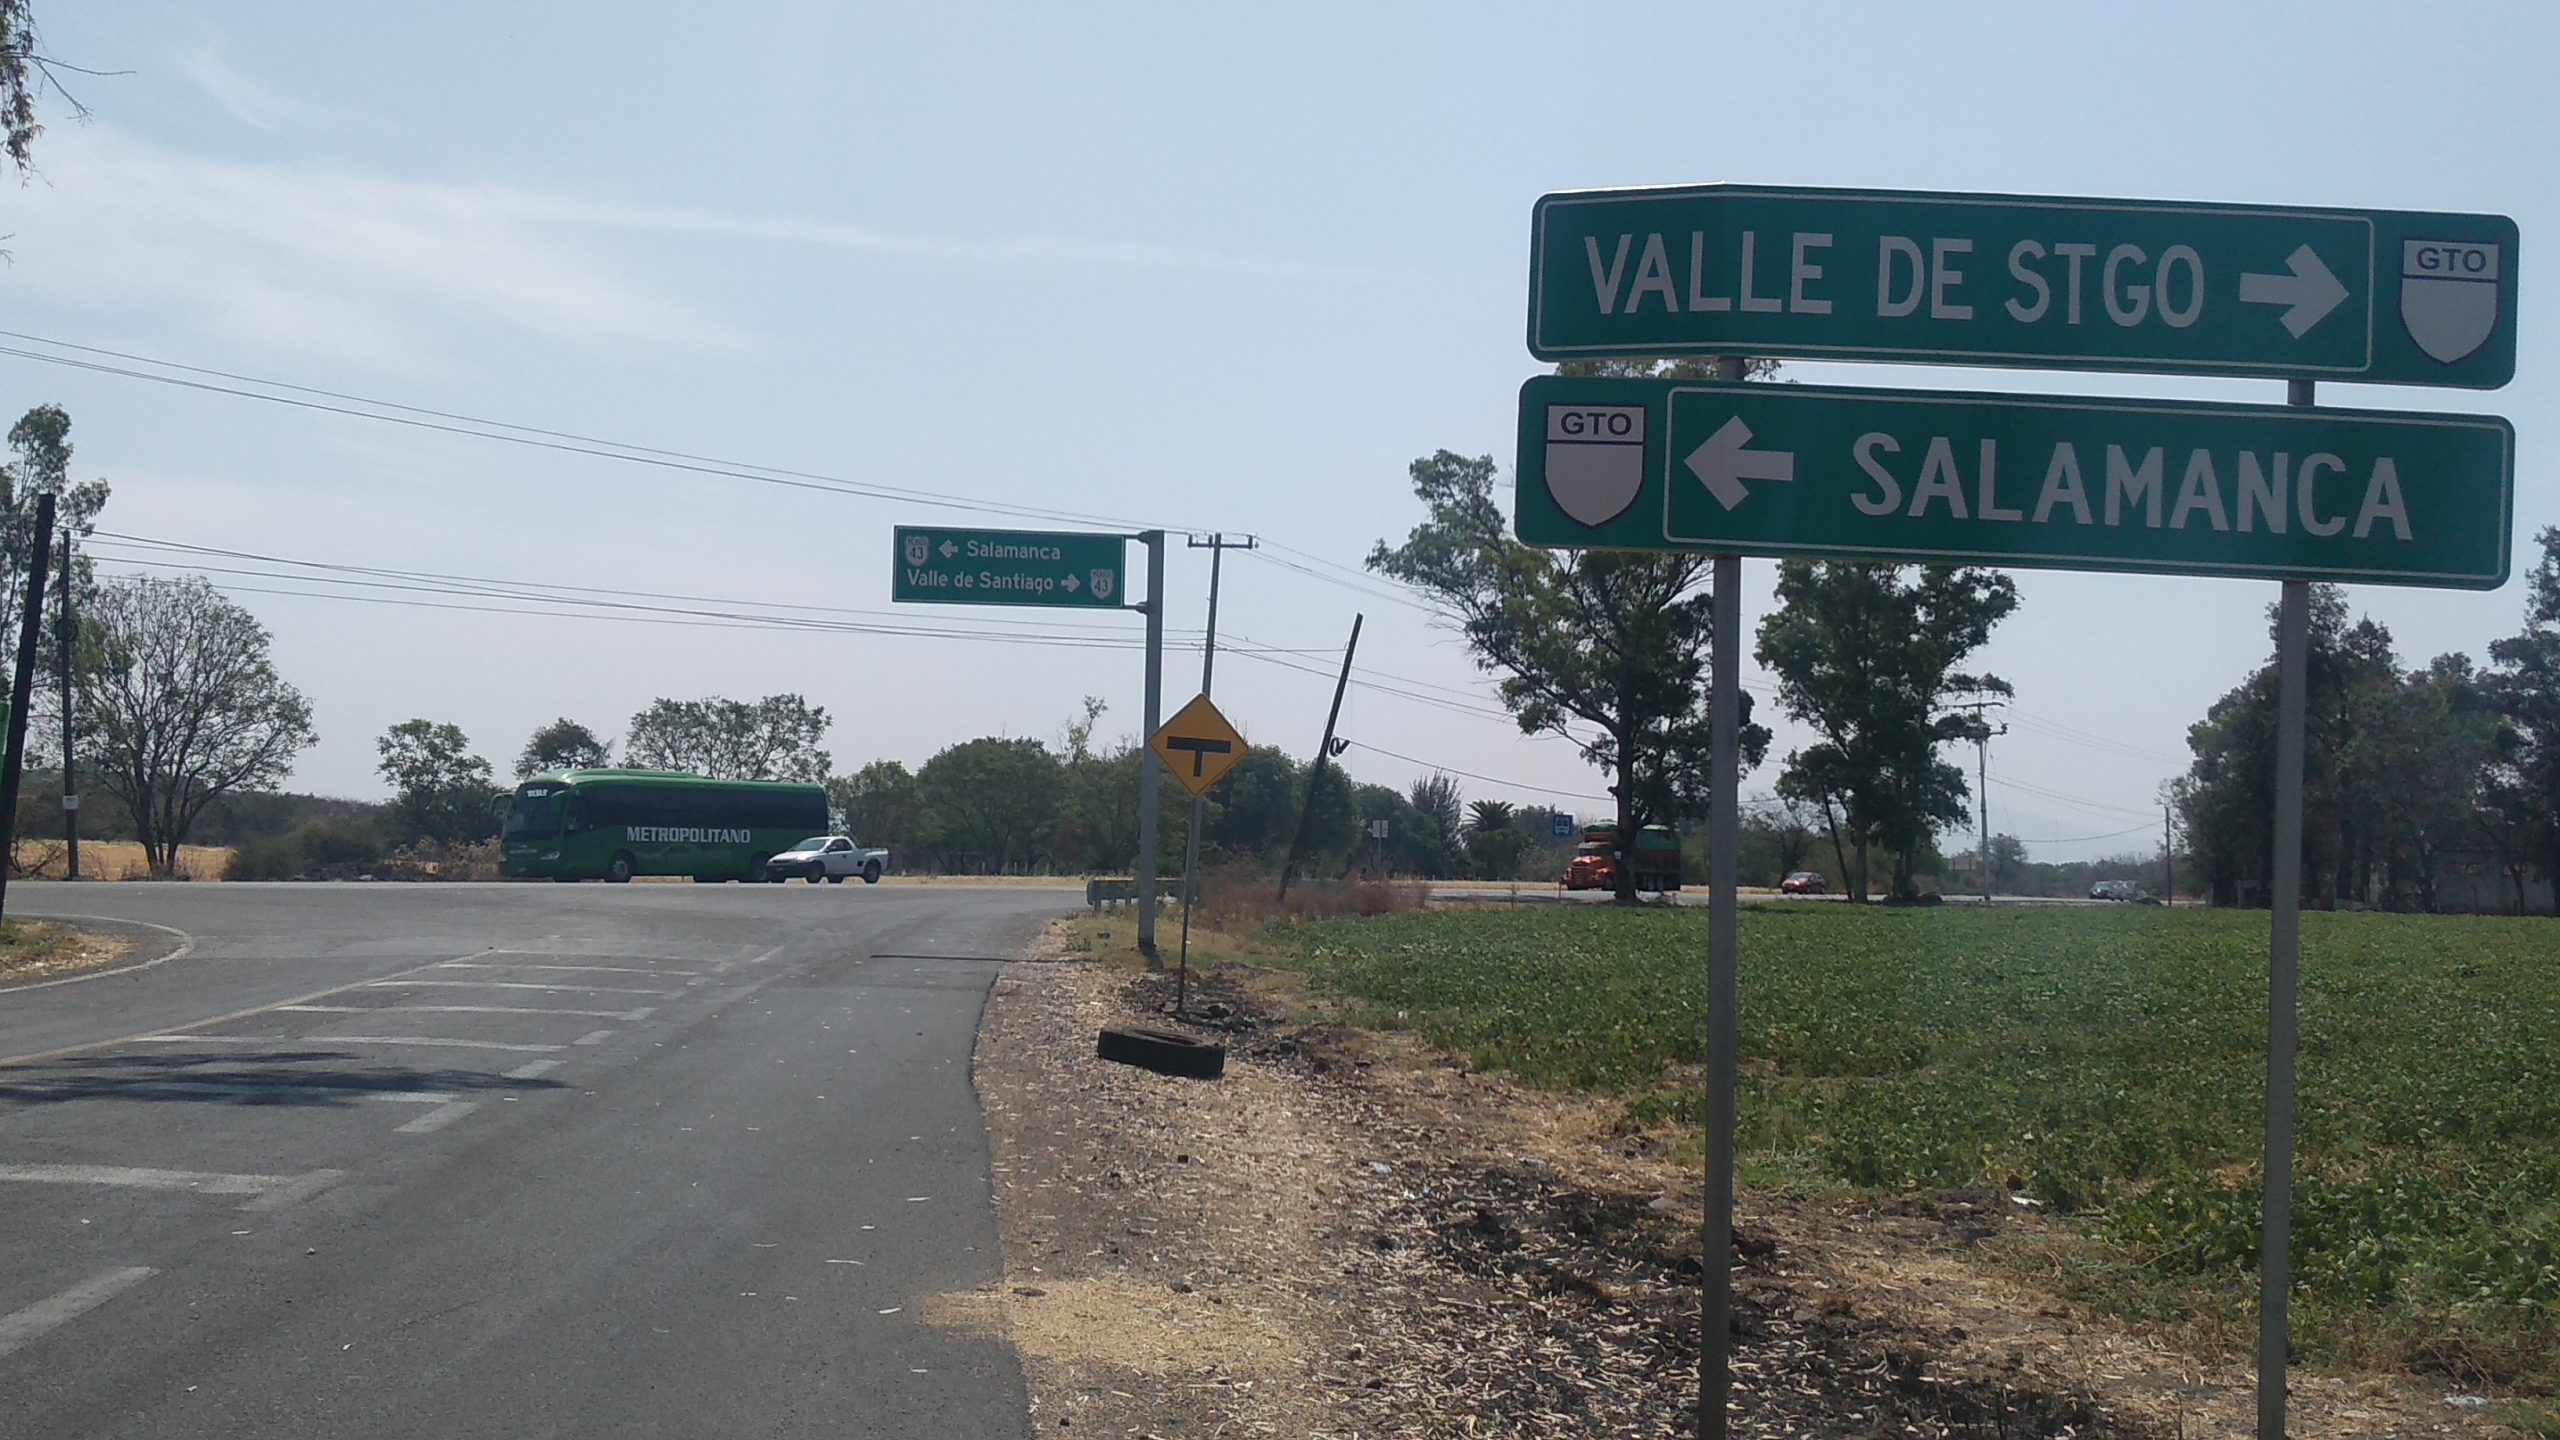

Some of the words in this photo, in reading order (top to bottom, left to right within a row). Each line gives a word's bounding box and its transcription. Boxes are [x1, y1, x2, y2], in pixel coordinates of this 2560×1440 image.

[2415, 246, 2490, 275] GTO
[1584, 229, 1834, 316] VALLE
[1876, 234, 1974, 321] DE
[2004, 238, 2205, 329] STGO
[1560, 410, 1633, 438] GTO
[1849, 431, 2413, 541] SALAMANCA
[909, 547, 924, 560] 43
[967, 540, 1062, 561] Salamanca
[906, 569, 949, 588] Valle
[954, 571, 974, 589] de
[979, 572, 1054, 595] Santiago
[1094, 579, 1108, 592] 43
[626, 825, 752, 845] METROPOLITANO
